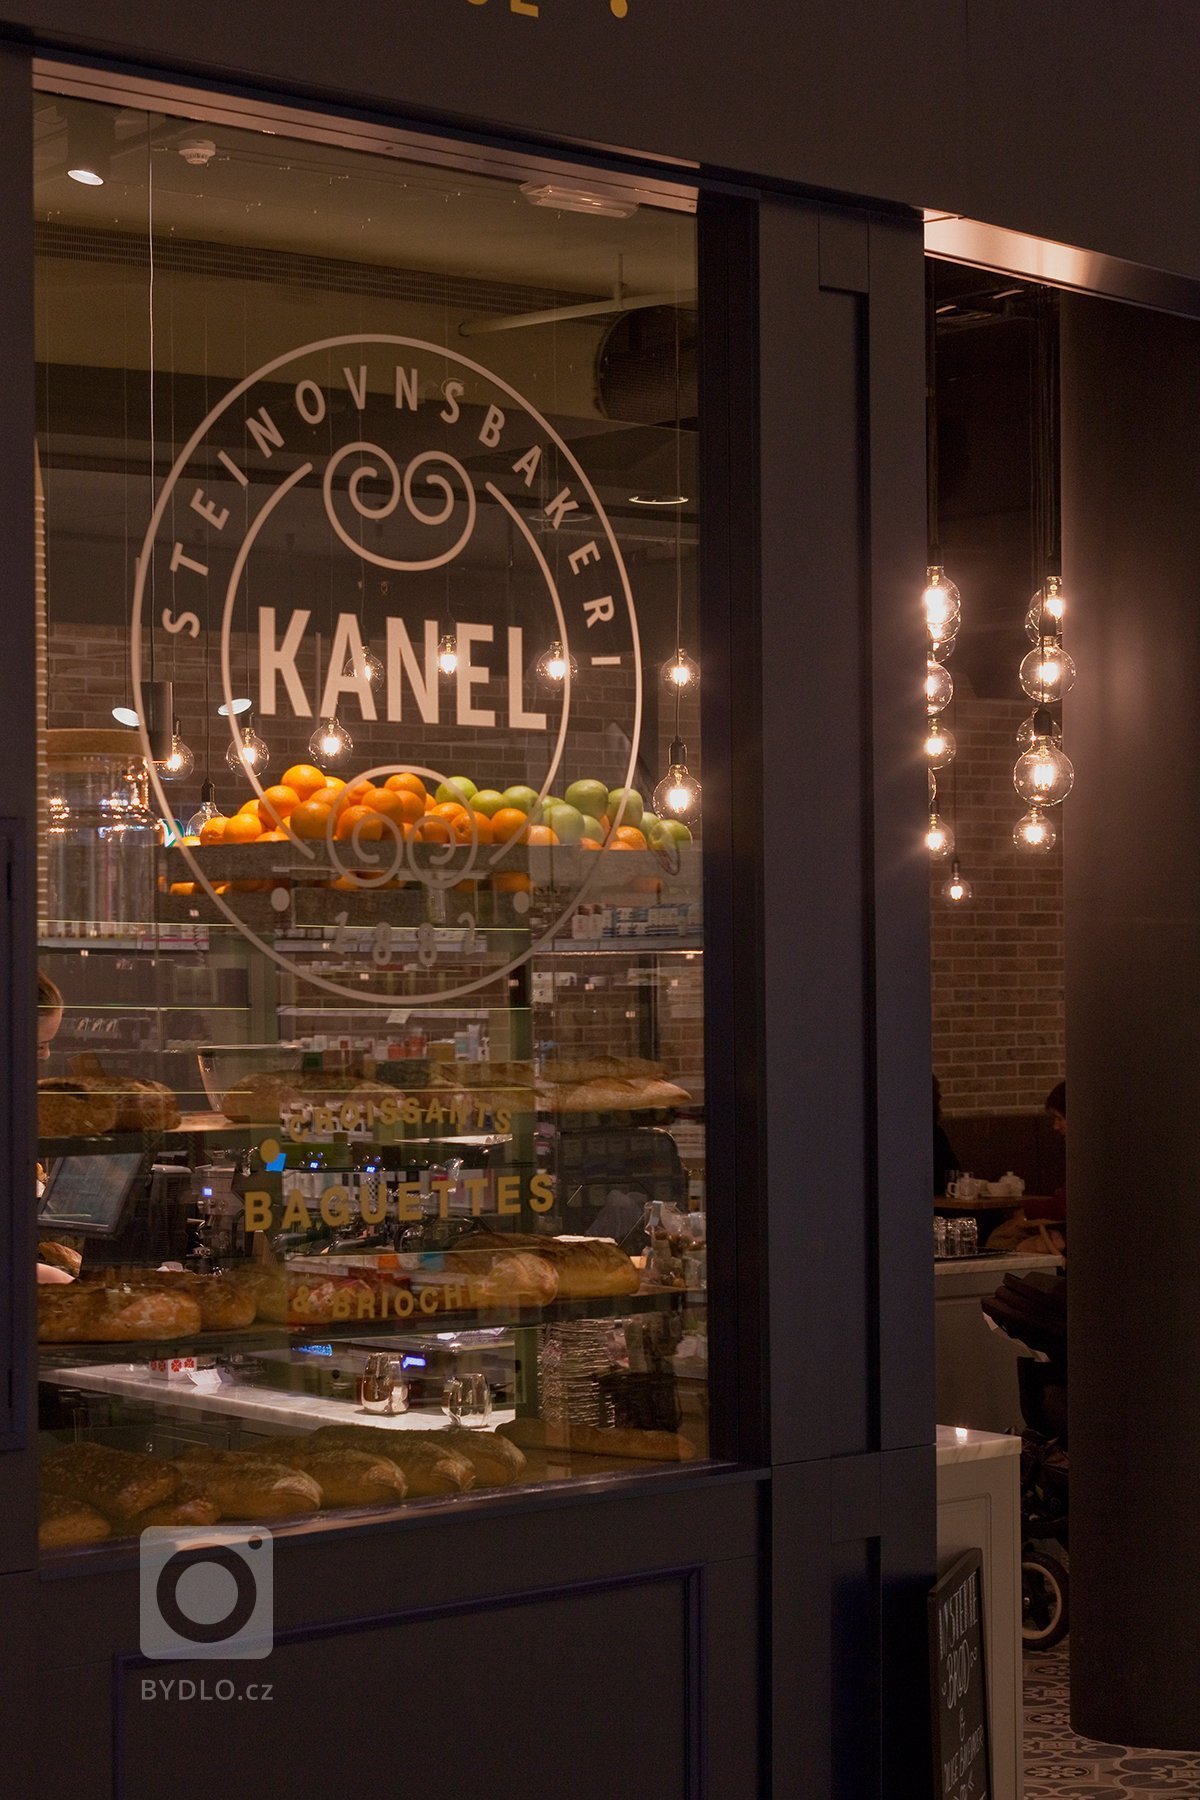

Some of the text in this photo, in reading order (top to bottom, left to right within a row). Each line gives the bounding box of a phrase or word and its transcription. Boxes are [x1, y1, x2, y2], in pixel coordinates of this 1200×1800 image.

[162, 365, 621, 666] STEINOVNSBAKERI
[258, 605, 547, 731] KANEL
[334, 911, 476, 966] 1882
[288, 1097, 512, 1143] CROISSANTS
[243, 1173, 556, 1232] BAGUETTES
[292, 1285, 310, 1314] &
